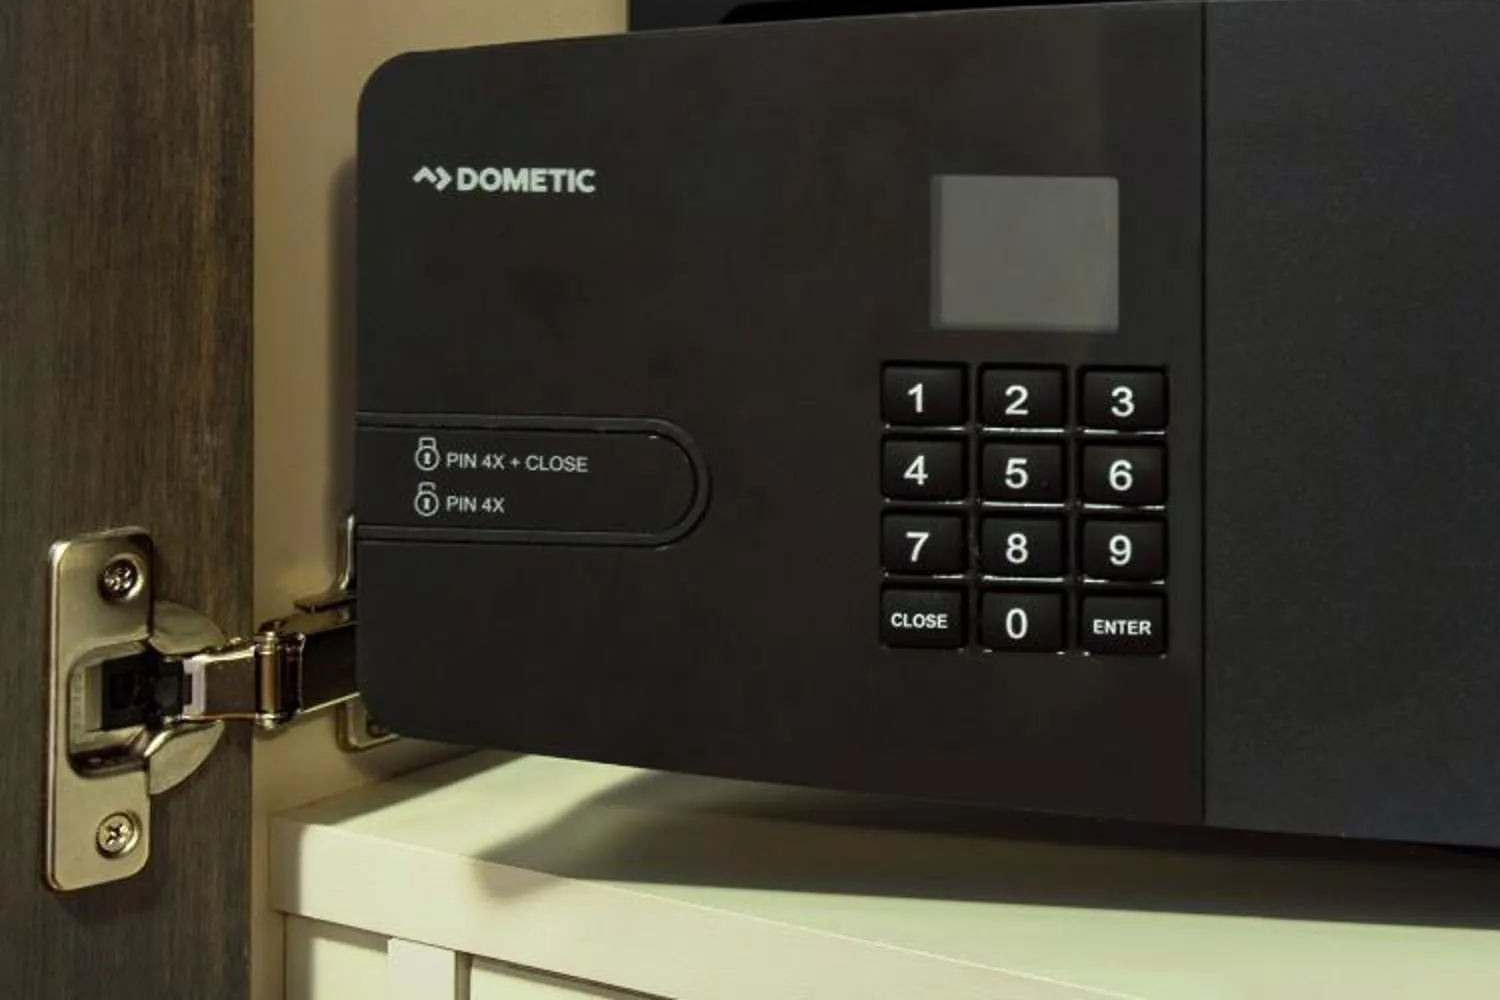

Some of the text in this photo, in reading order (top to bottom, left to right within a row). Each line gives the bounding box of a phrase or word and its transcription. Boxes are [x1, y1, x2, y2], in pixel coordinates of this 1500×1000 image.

[456, 166, 597, 193] DOMETIC
[907, 382, 924, 413] 1
[1004, 384, 1029, 416] 2
[1111, 385, 1135, 417] 3
[446, 452, 477, 469] PIN
[481, 453, 505, 470] 4X
[525, 455, 589, 473] CLOSE
[902, 454, 929, 485] 4
[1004, 457, 1029, 489] 5
[1108, 459, 1133, 491] 6
[446, 495, 505, 513] PIN 4X
[905, 530, 930, 562] 7
[1005, 532, 1029, 564] 8
[1108, 534, 1132, 565] 9
[890, 612, 949, 629] CLOSE
[1005, 607, 1029, 639] 0
[1092, 619, 1153, 636] ENTER
